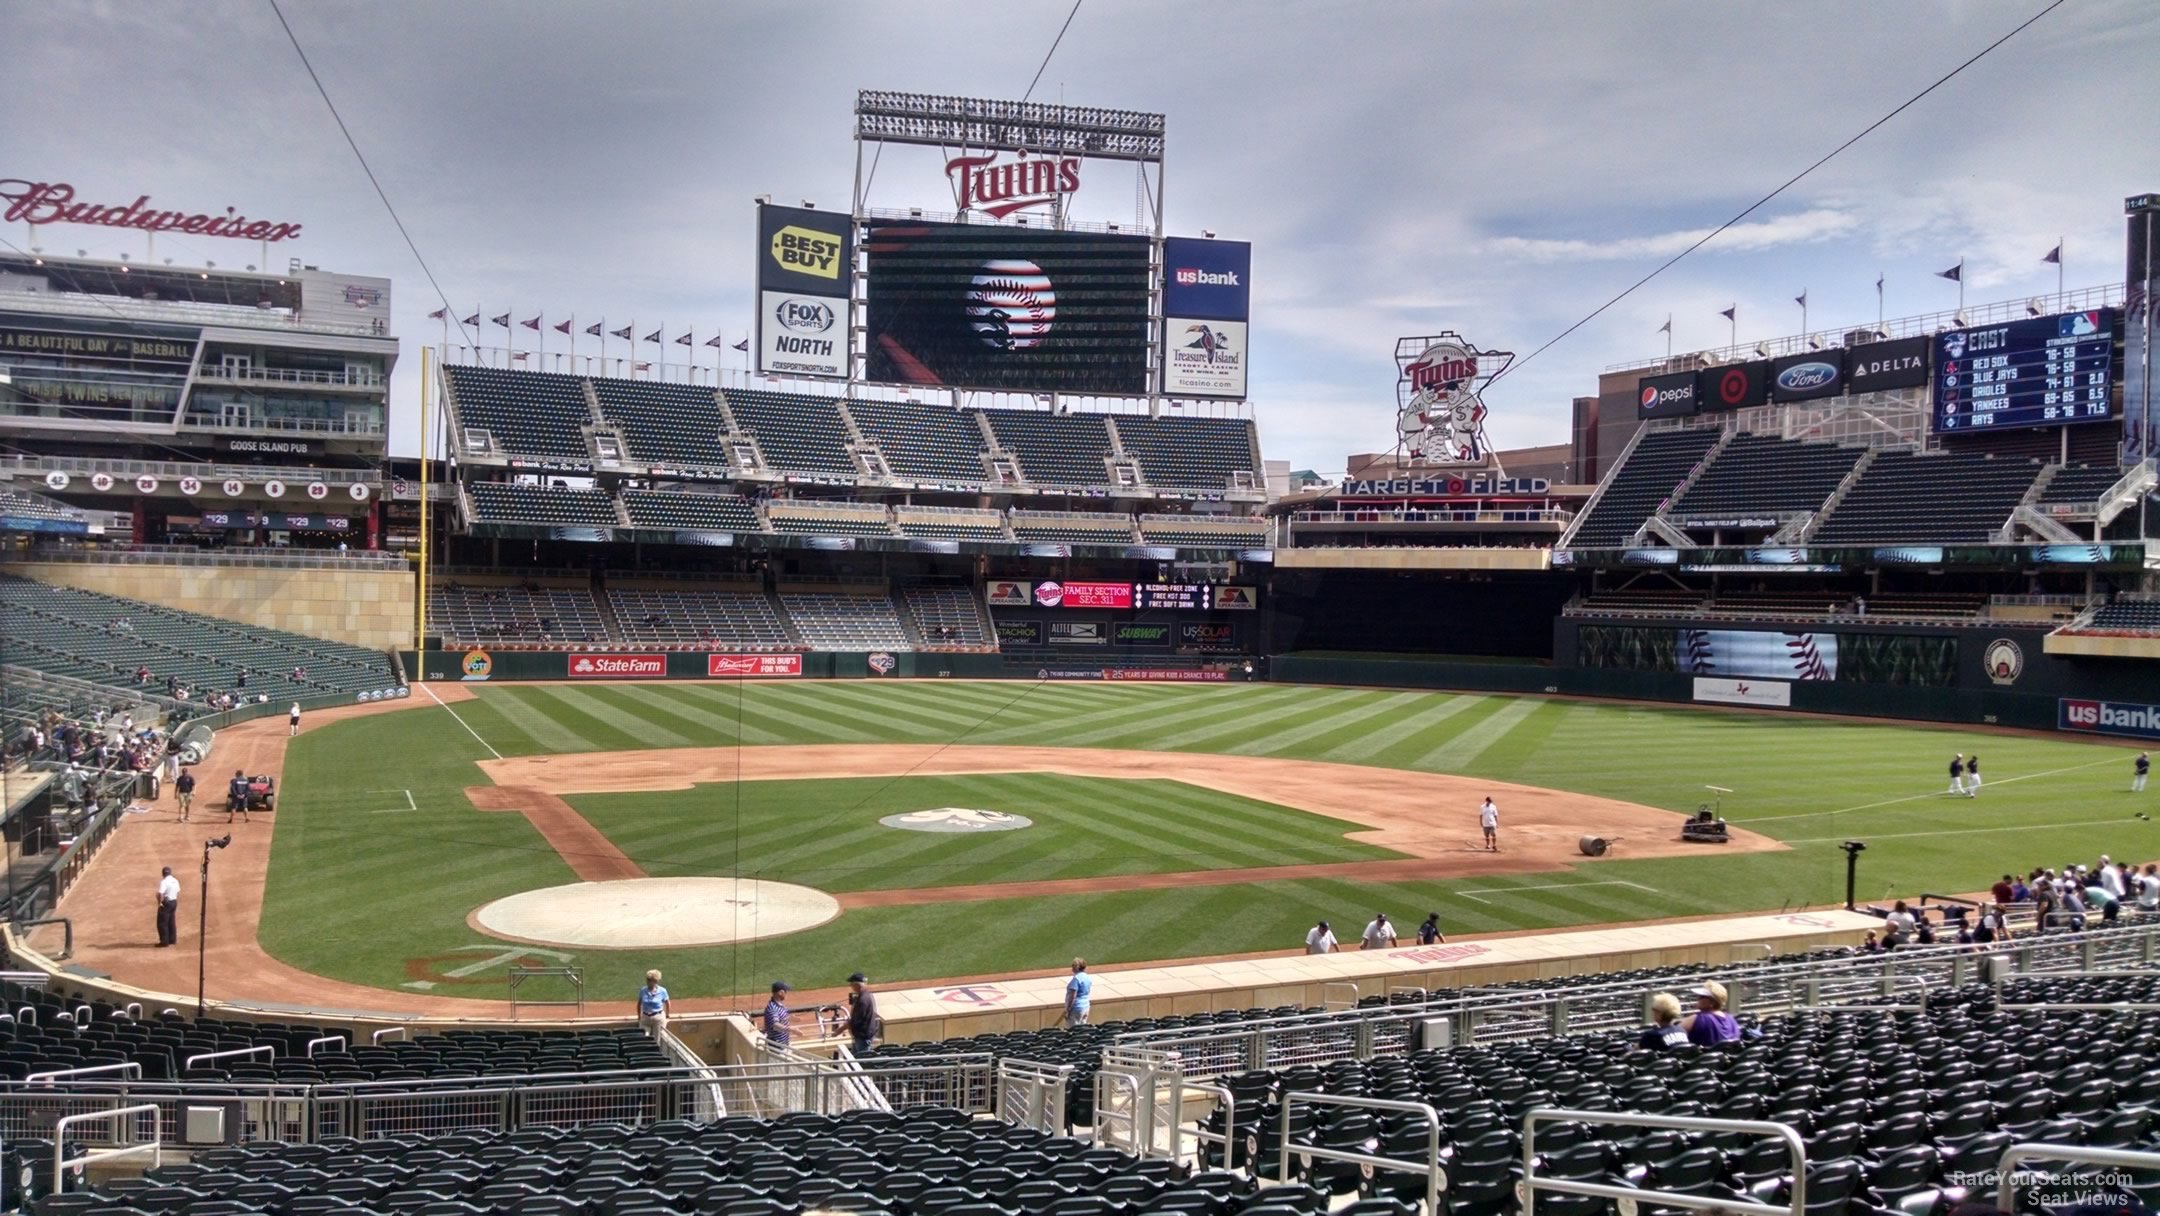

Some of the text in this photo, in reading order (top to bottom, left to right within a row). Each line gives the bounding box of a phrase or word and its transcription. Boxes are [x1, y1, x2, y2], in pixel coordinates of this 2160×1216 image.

[944, 148, 1081, 215] Twins
[0, 179, 302, 242] Budweiser
[781, 233, 839, 256] BEST
[782, 249, 834, 271] BUY
[788, 303, 823, 322] FOX
[788, 319, 823, 329] SPORTS
[6, 334, 15, 346] A
[18, 335, 85, 351] BEAUTIFUL
[87, 339, 109, 352] DAY
[132, 342, 190, 358] BASEBALL
[776, 335, 833, 356] NORTH
[1968, 328, 2009, 352] EAST
[1173, 349, 1239, 364] Treasure Island
[772, 361, 838, 374] FOXSPORTSNORTH.COM
[1871, 355, 1922, 373] DELTA
[1973, 358, 1990, 370] RED
[1991, 356, 2009, 368] SOX
[1404, 355, 1478, 393] Twins
[1787, 366, 1825, 388] Ford
[1973, 371, 1995, 384] BLUE
[1996, 368, 2018, 381] JAYS
[1179, 379, 1232, 388] ticasino.com
[1972, 384, 2007, 398] ORIOLES
[2089, 373, 2104, 385] 2.0
[27, 383, 50, 395] THIS
[64, 385, 109, 402] TWINS
[1659, 384, 1693, 405] pepsi
[1972, 398, 2010, 412] YANKEES
[1972, 413, 1994, 426] RAYS
[230, 440, 308, 454] GOOSE ISLAND PUB
[51, 476, 64, 485] 42
[184, 481, 197, 490] 34
[1342, 478, 1550, 495] TARGET FIELD
[228, 482, 239, 492] 14
[271, 484, 278, 493] 6
[311, 485, 324, 495] 29
[356, 487, 363, 496] 3
[216, 514, 229, 524] 29
[297, 516, 309, 526] 29
[335, 518, 348, 528] 29
[1035, 587, 1063, 602] Twins
[1064, 586, 1129, 596] FAMILY SECTION
[1184, 585, 1198, 593] ZONE
[1079, 595, 1114, 605] SEC. 311
[1149, 600, 1162, 608] FREE
[996, 628, 1036, 637] STACHIOS
[1051, 623, 1072, 633] ALTEC
[1117, 627, 1168, 639] SUBWAY
[465, 662, 488, 670] VOTE
[761, 657, 797, 665] THIS BUD'S
[880, 657, 895, 668] 29
[760, 665, 790, 673] FOR YOU.
[1112, 670, 1124, 679] 25
[429, 672, 444, 680] 339
